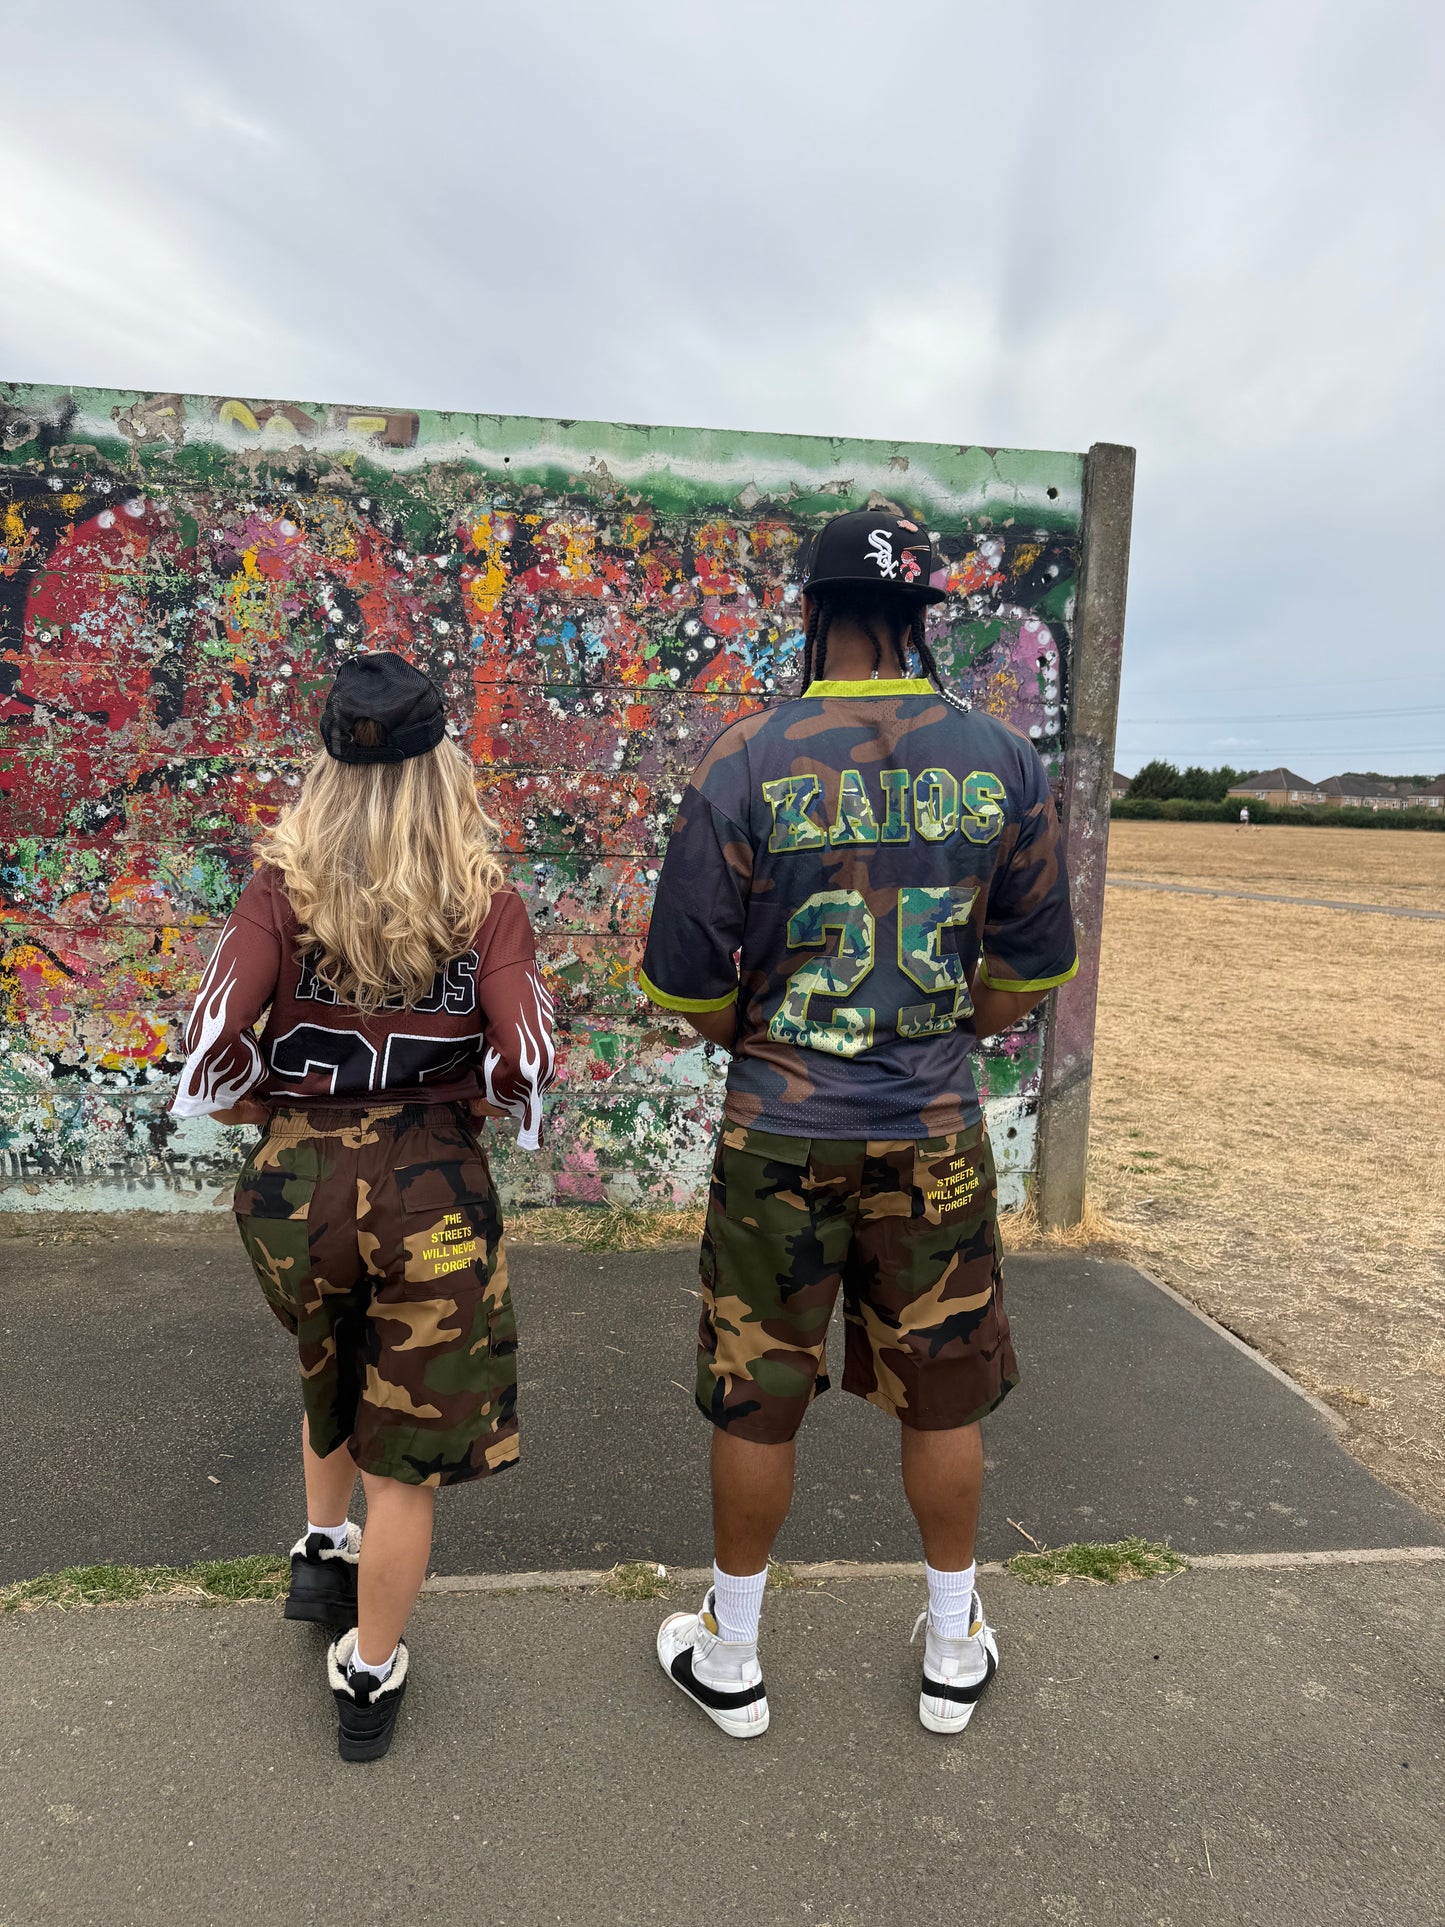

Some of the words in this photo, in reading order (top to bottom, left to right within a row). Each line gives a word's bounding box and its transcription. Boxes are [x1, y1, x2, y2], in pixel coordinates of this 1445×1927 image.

[762, 767, 1007, 854] KAIOS
[766, 886, 981, 1059] 25
[949, 1157, 966, 1171] THE
[936, 1166, 975, 1187] STREETS
[927, 1190, 953, 1200] WILL
[954, 1177, 980, 1196] NEVER
[938, 1193, 973, 1213] FORGET
[443, 1212, 462, 1225] THE
[431, 1226, 472, 1243] STREETS
[422, 1246, 450, 1260] WILL
[452, 1240, 477, 1255] NEVER
[434, 1257, 472, 1274] FORGET
